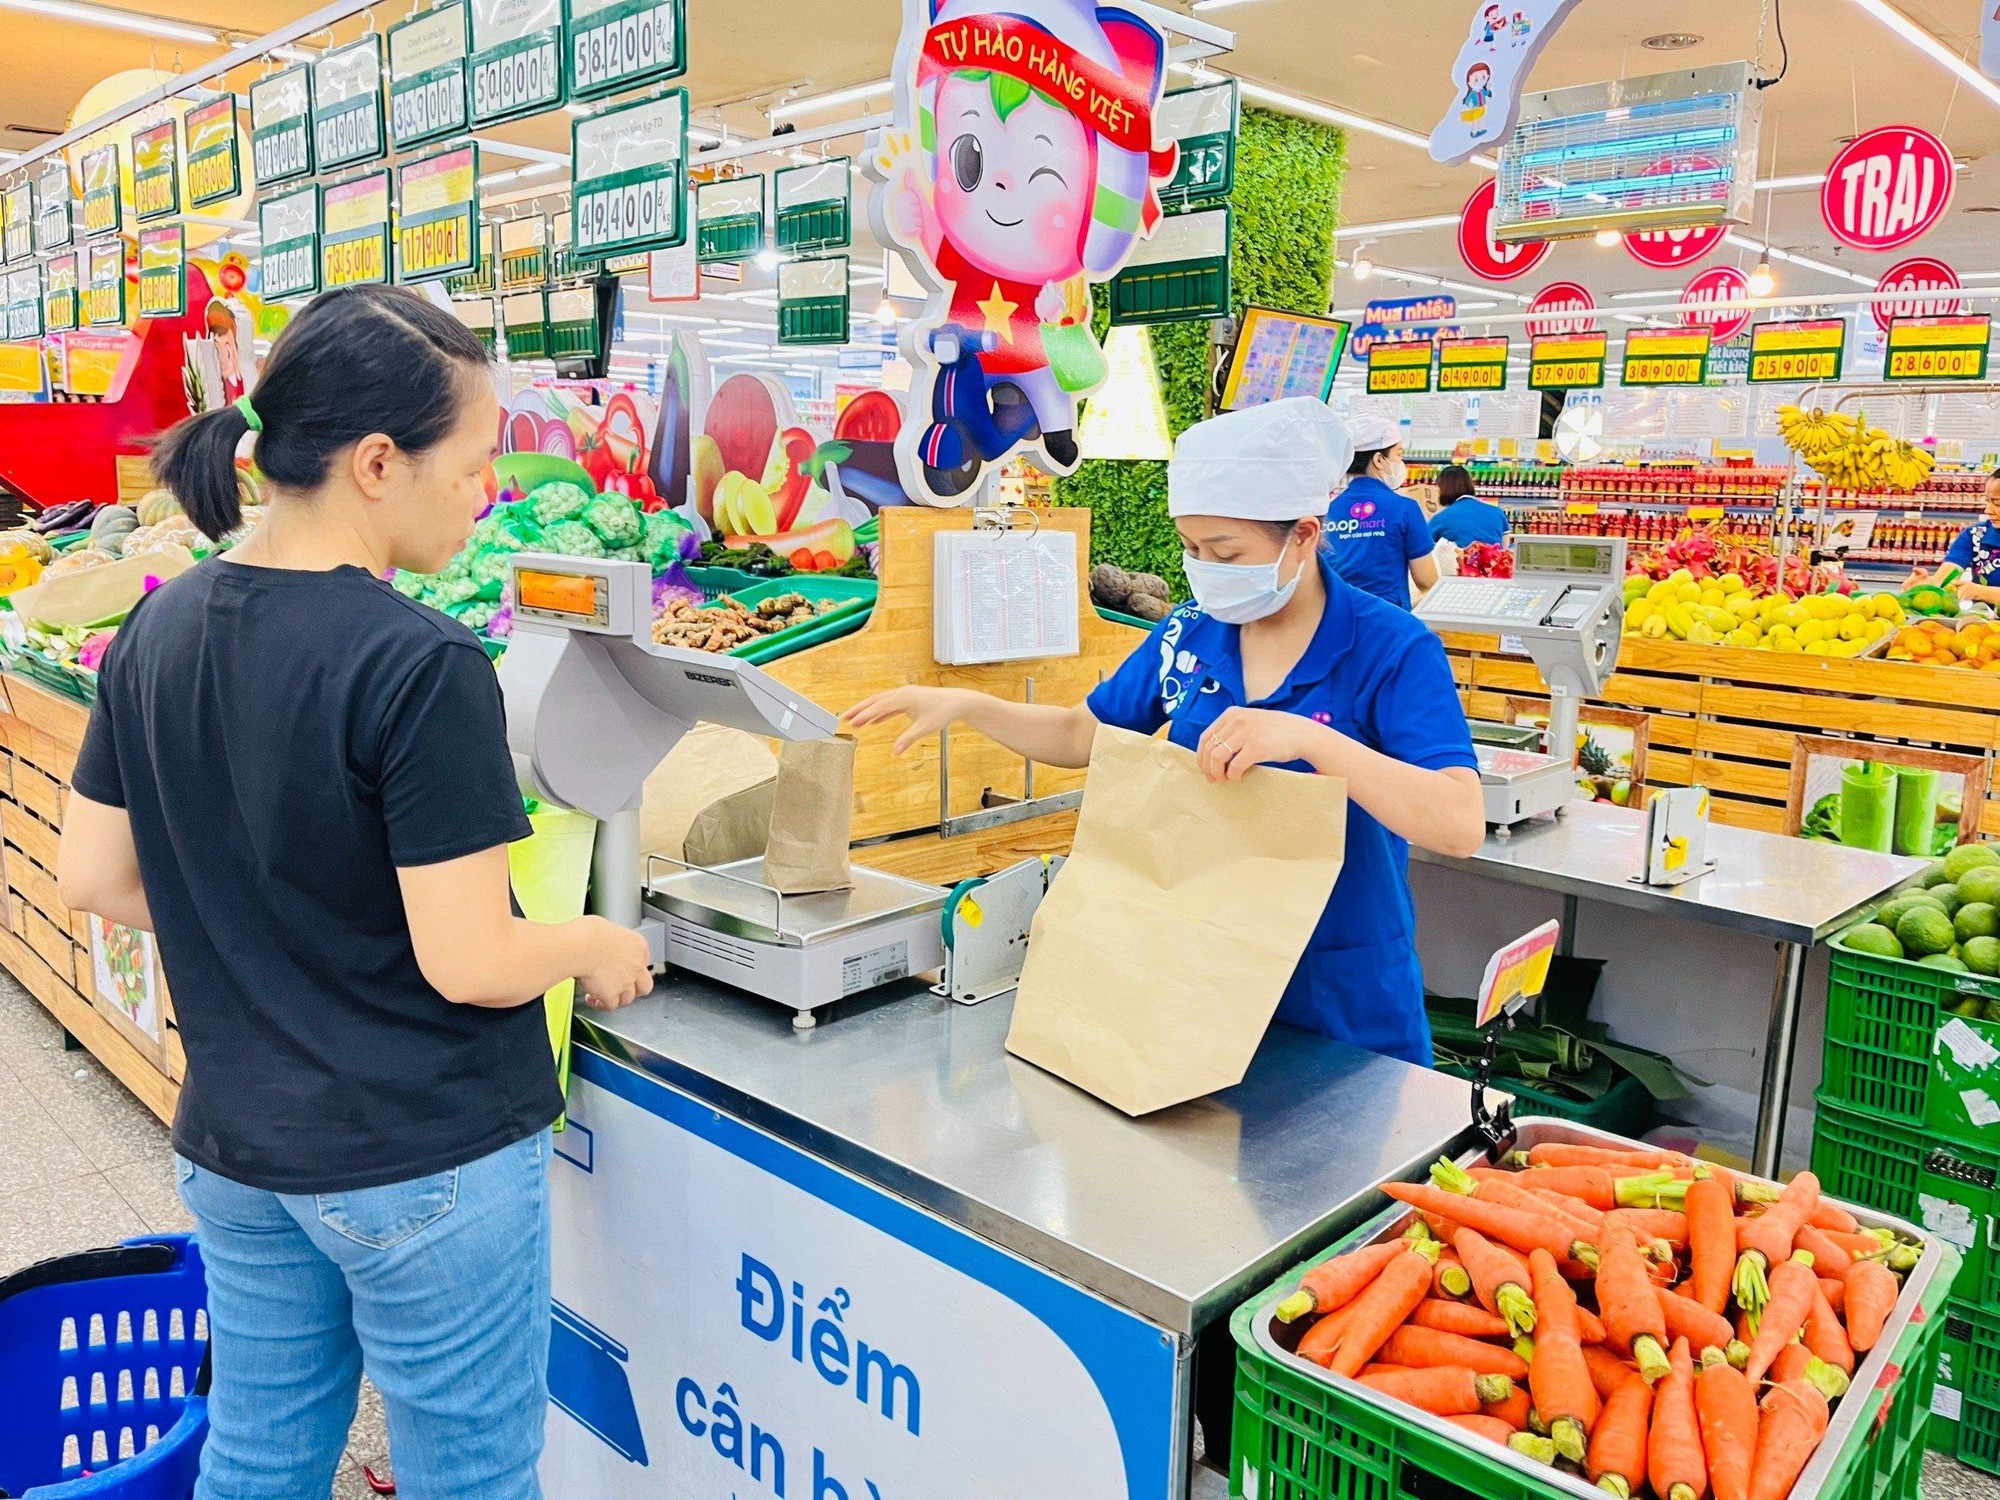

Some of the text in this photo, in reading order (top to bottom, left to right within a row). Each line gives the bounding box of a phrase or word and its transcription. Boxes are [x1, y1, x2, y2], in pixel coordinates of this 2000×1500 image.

[578, 21, 652, 76] 58.200
[477, 57, 538, 104] 50.800
[934, 23, 1135, 135] TỰ HÀO HÀNG VIỆT
[1624, 88, 1662, 101] KILLER
[395, 87, 448, 131] 33.900
[1841, 135, 1935, 237] TRÁI
[581, 191, 653, 236] 49.400
[1366, 297, 1454, 324] Mua nhiều
[1535, 366, 1586, 382] 57.900
[1757, 357, 1818, 376] 25.900
[1893, 354, 1961, 373] 28.600
[736, 1252, 920, 1438] Điểm
[676, 1377, 785, 1500] cân
